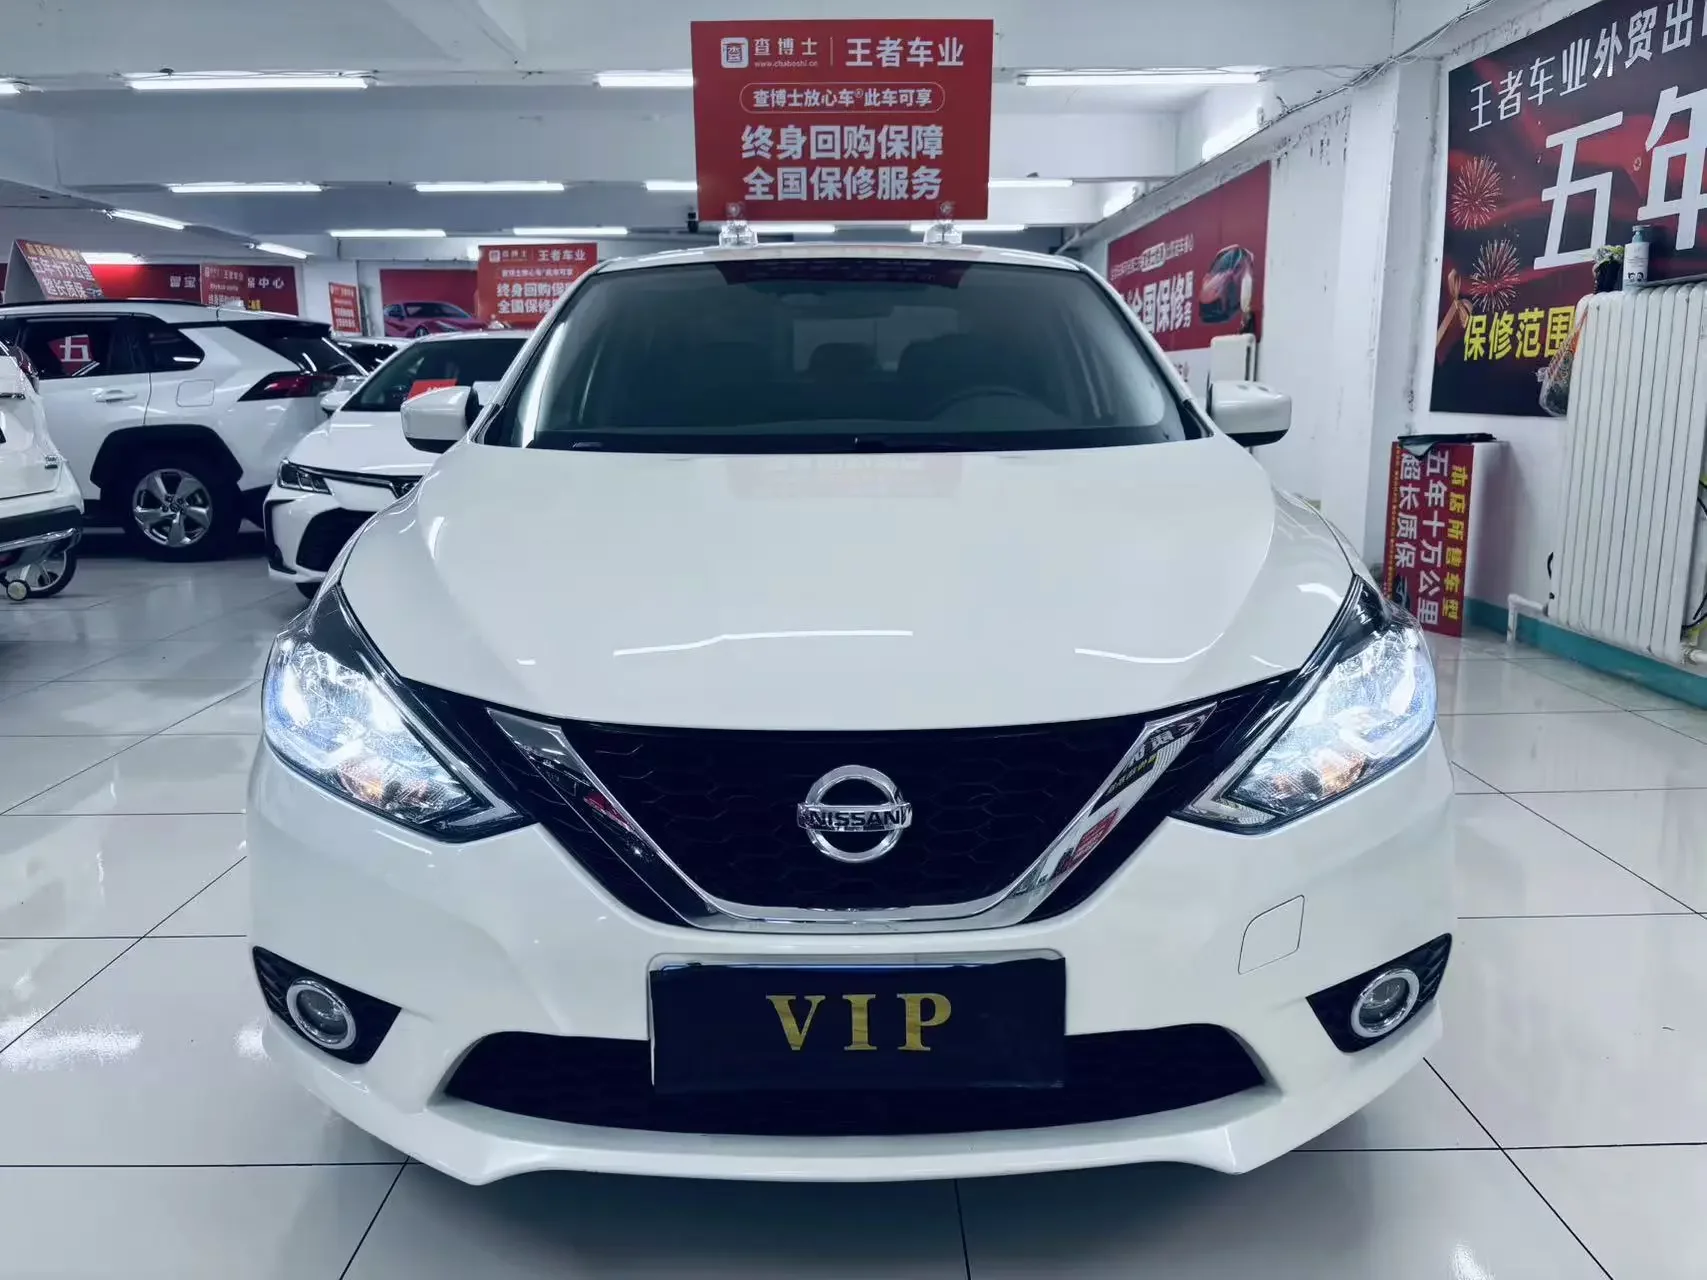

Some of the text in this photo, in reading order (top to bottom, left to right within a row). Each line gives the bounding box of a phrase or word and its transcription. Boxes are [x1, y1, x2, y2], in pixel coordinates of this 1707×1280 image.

[753, 37, 818, 56] 查博士
[844, 36, 964, 67] 王者车业
[1468, 0, 1707, 132] 王者车业外贸出
[741, 124, 944, 160] 终身回购保障
[743, 166, 942, 201] 全国保修服务
[538, 249, 586, 262] 王者车业
[1464, 306, 1575, 361] 保修范围
[1395, 453, 1421, 568] 超长质保
[1418, 450, 1449, 625] 五年十万公里
[809, 810, 902, 827] NISSAN
[766, 993, 952, 1051] VIP
